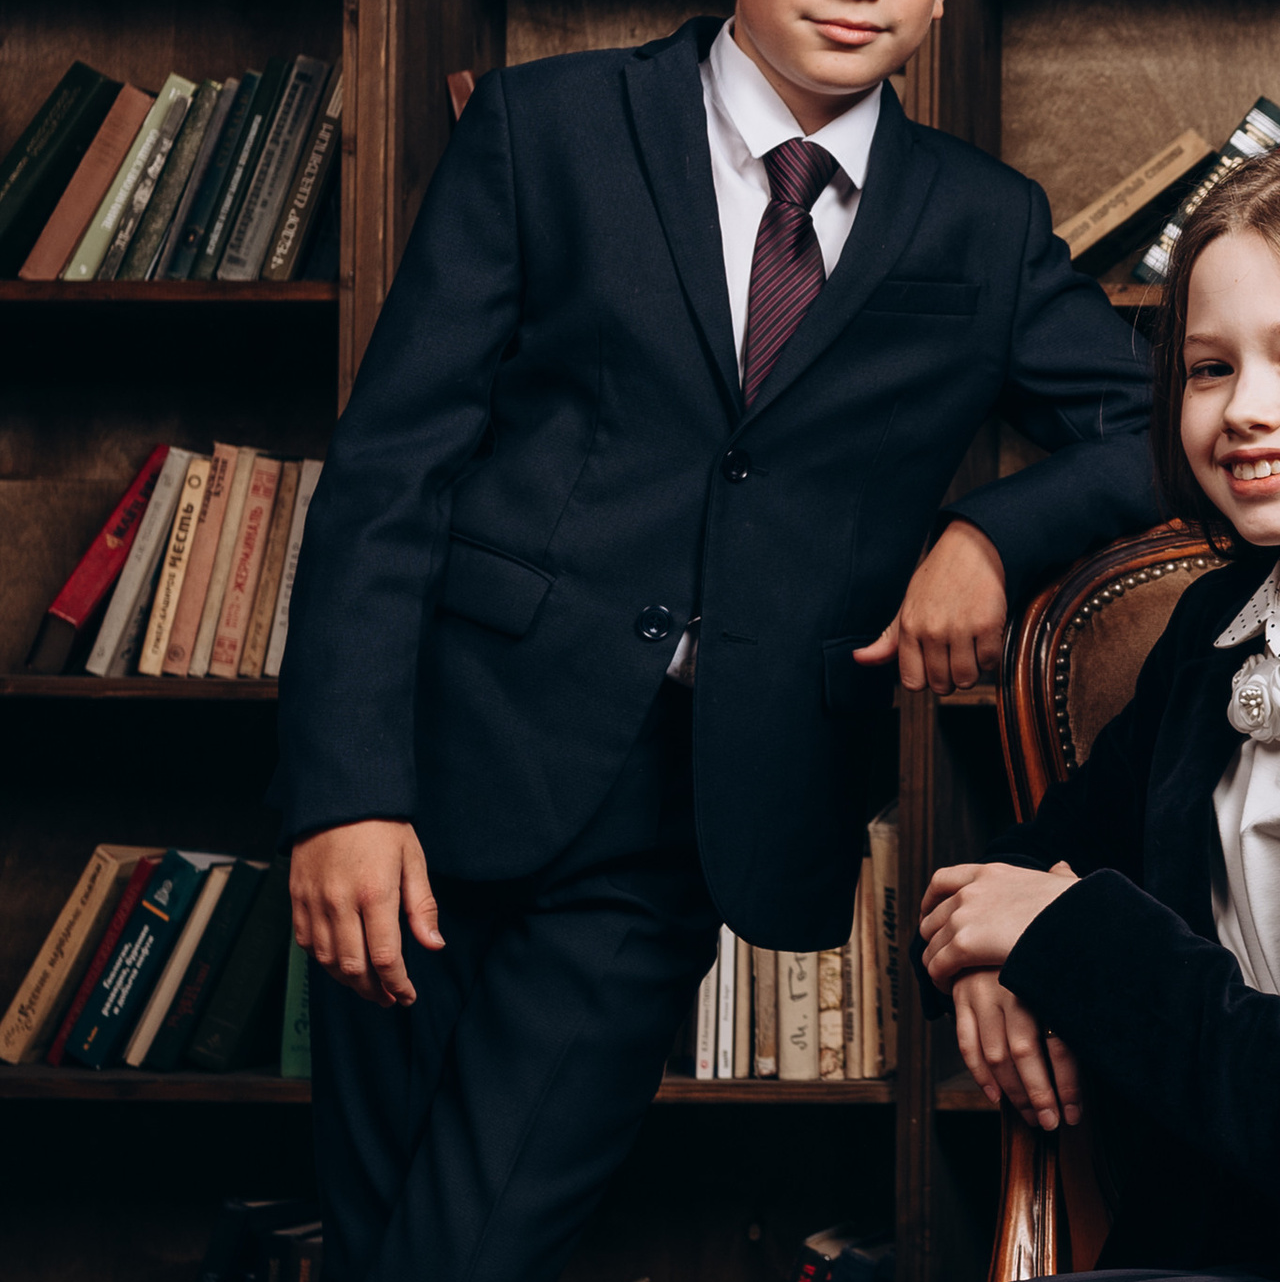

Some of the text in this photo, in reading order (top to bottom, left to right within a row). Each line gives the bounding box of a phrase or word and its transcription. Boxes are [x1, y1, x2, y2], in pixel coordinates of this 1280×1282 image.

[269, 206, 304, 272] ФЕДОР
[231, 504, 265, 593] ЖЕРМИНАЛЬ
[881, 886, 900, 942] Happy
